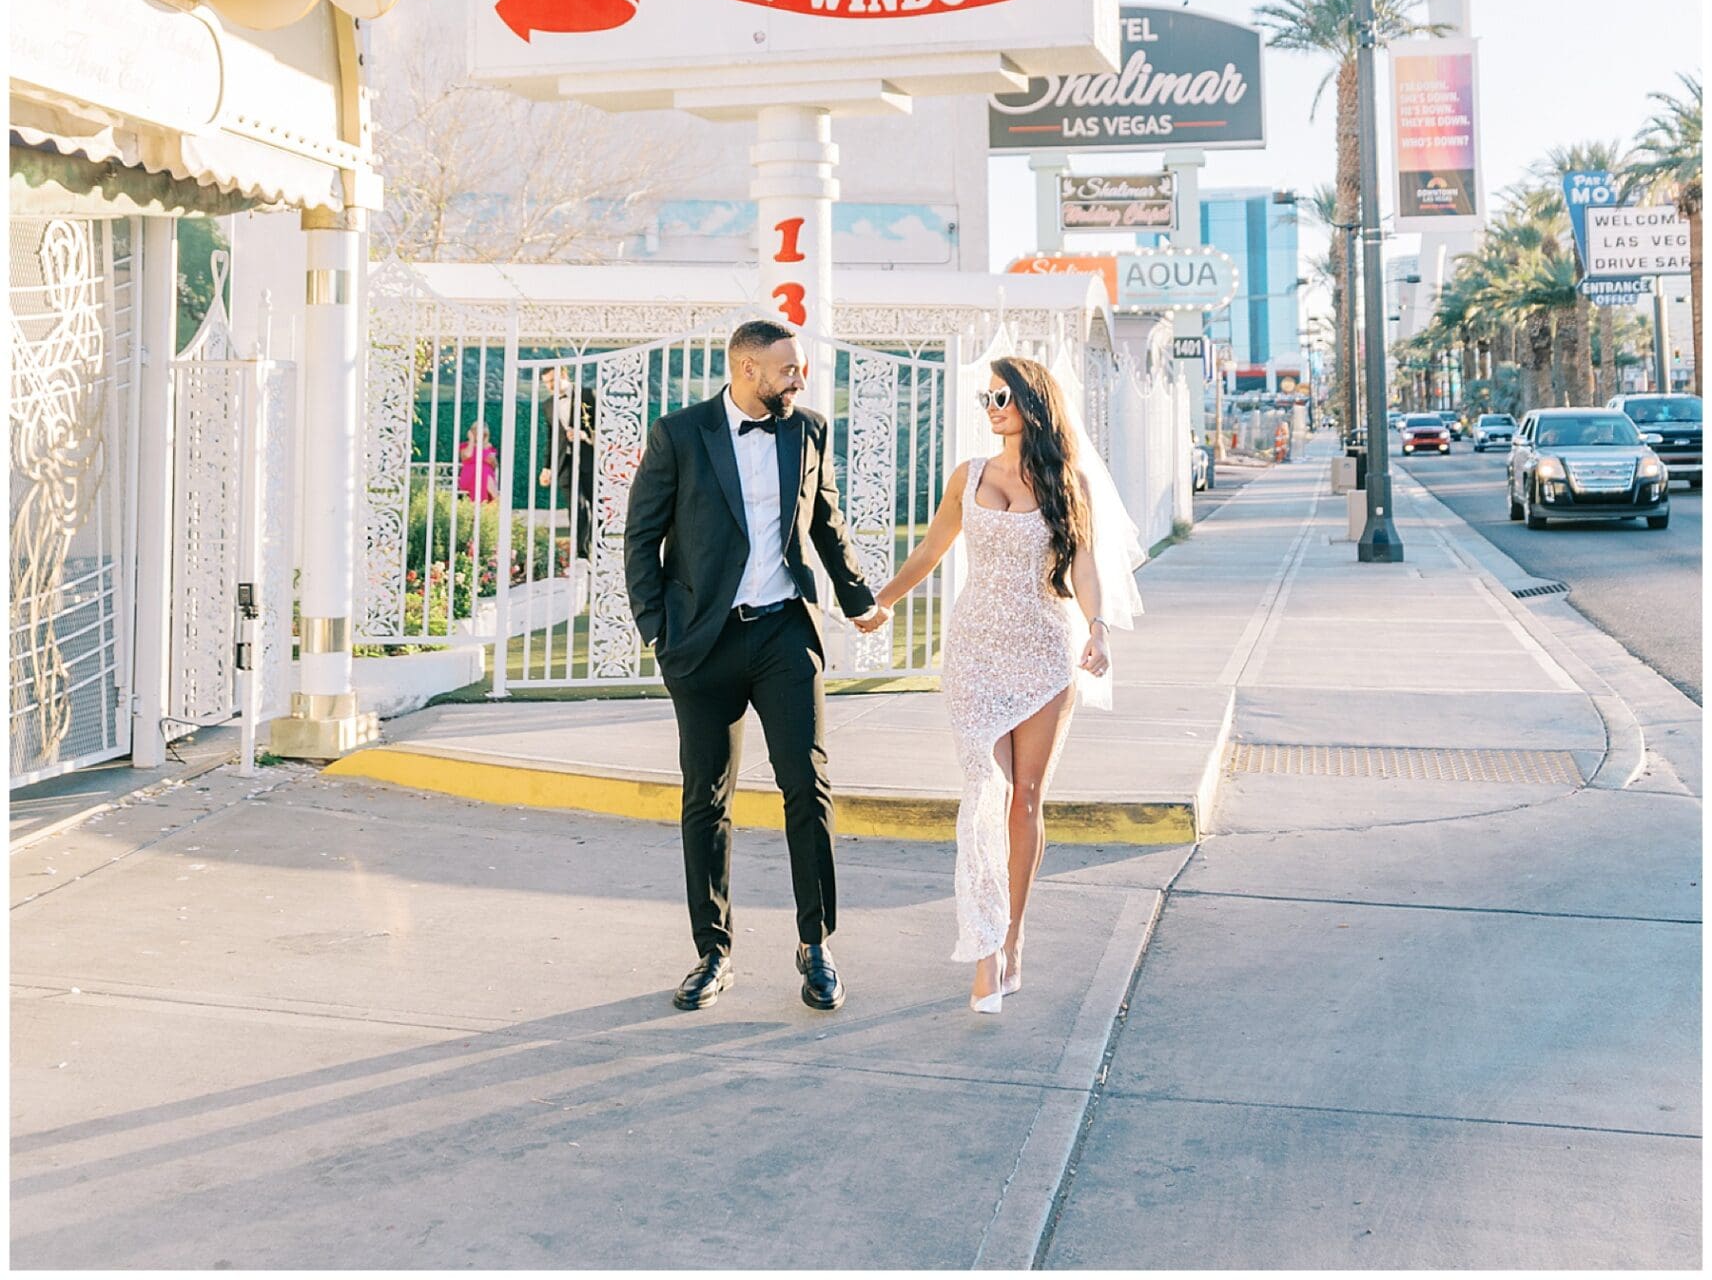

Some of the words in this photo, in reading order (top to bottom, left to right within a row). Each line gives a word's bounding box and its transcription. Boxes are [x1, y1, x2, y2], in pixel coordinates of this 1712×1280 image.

[1062, 118, 1100, 137] LAS
[1103, 115, 1173, 136] VEGAS
[1077, 177, 1157, 199] Shalimar
[1603, 236, 1639, 248] LAS
[1595, 257, 1648, 270] DRIVE
[1126, 262, 1218, 289] AQUA
[1582, 281, 1648, 295] ENTRANCE
[1596, 294, 1635, 305] OFFICE
[1174, 339, 1201, 356] 1401
